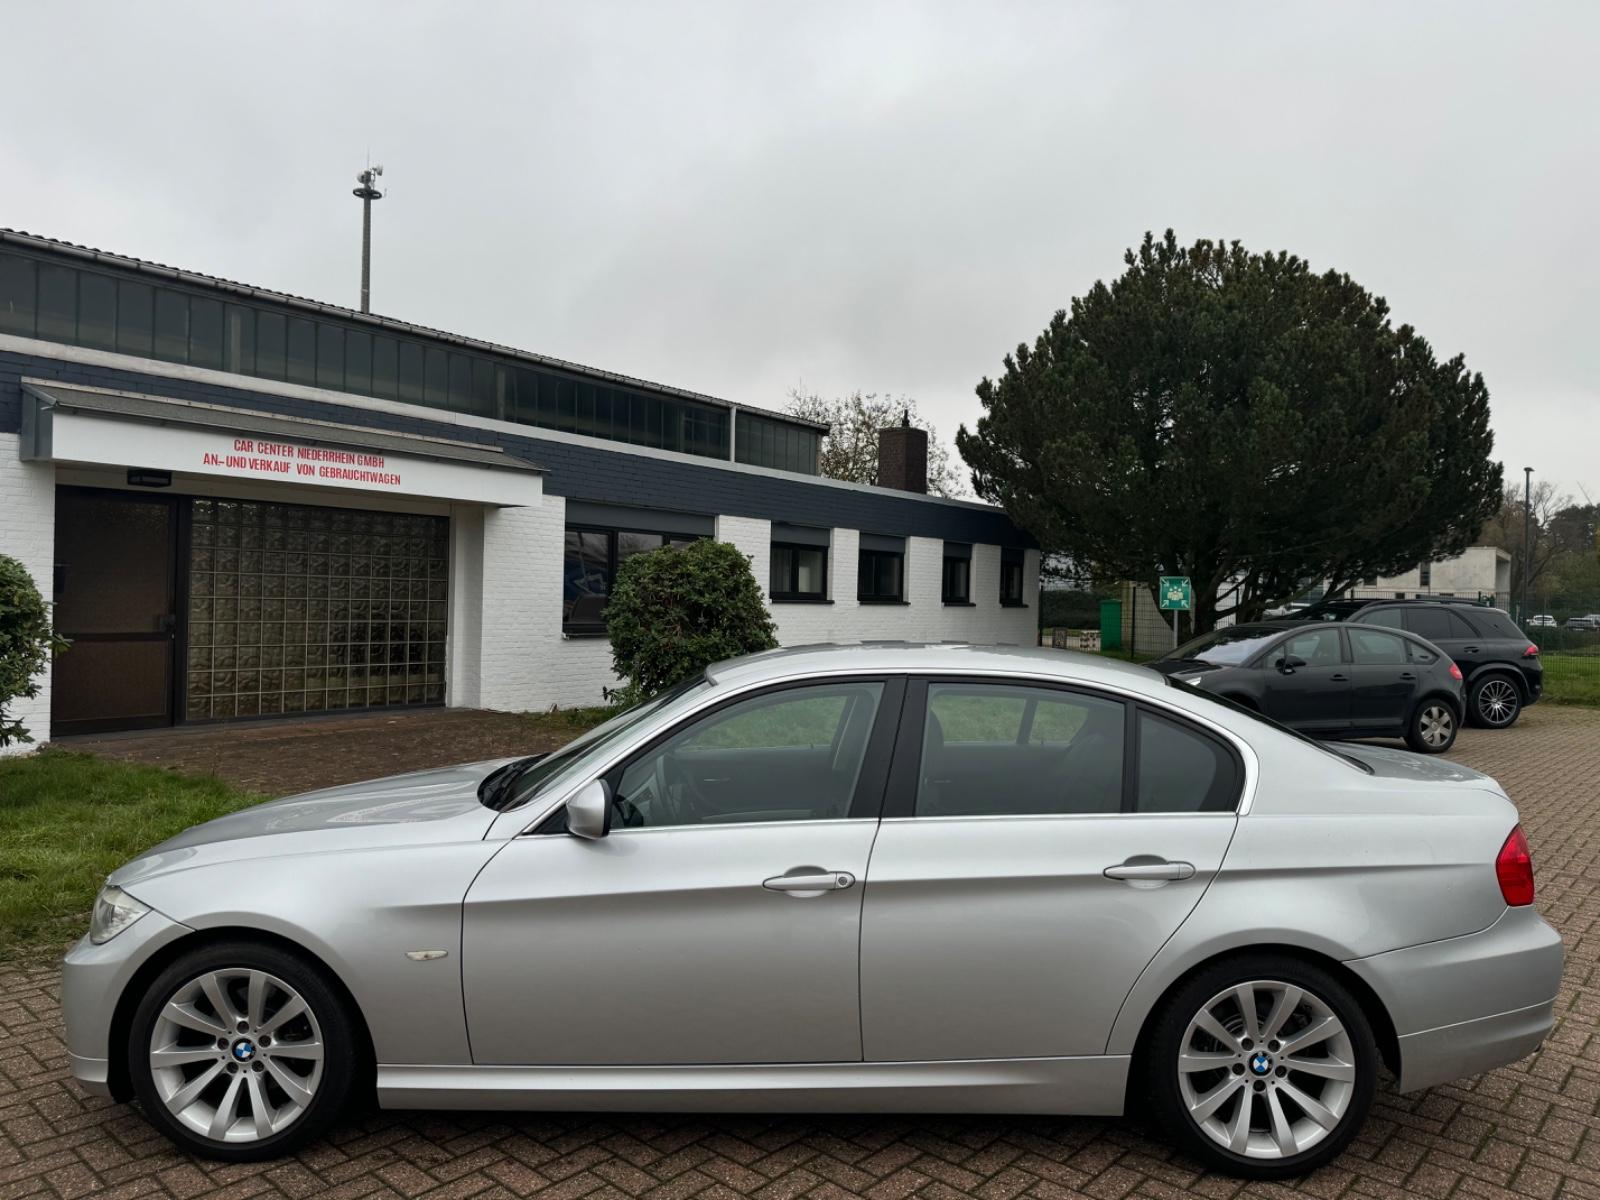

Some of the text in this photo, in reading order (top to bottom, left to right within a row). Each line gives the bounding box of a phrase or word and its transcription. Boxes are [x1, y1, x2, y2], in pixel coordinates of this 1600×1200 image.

[233, 439, 384, 468] CAR CENTER NIEDERRHEIN GMBH
[248, 457, 291, 473] VERKAUF
[296, 463, 315, 476] VON
[319, 466, 401, 485] GEBRAUCHTWAGEN
